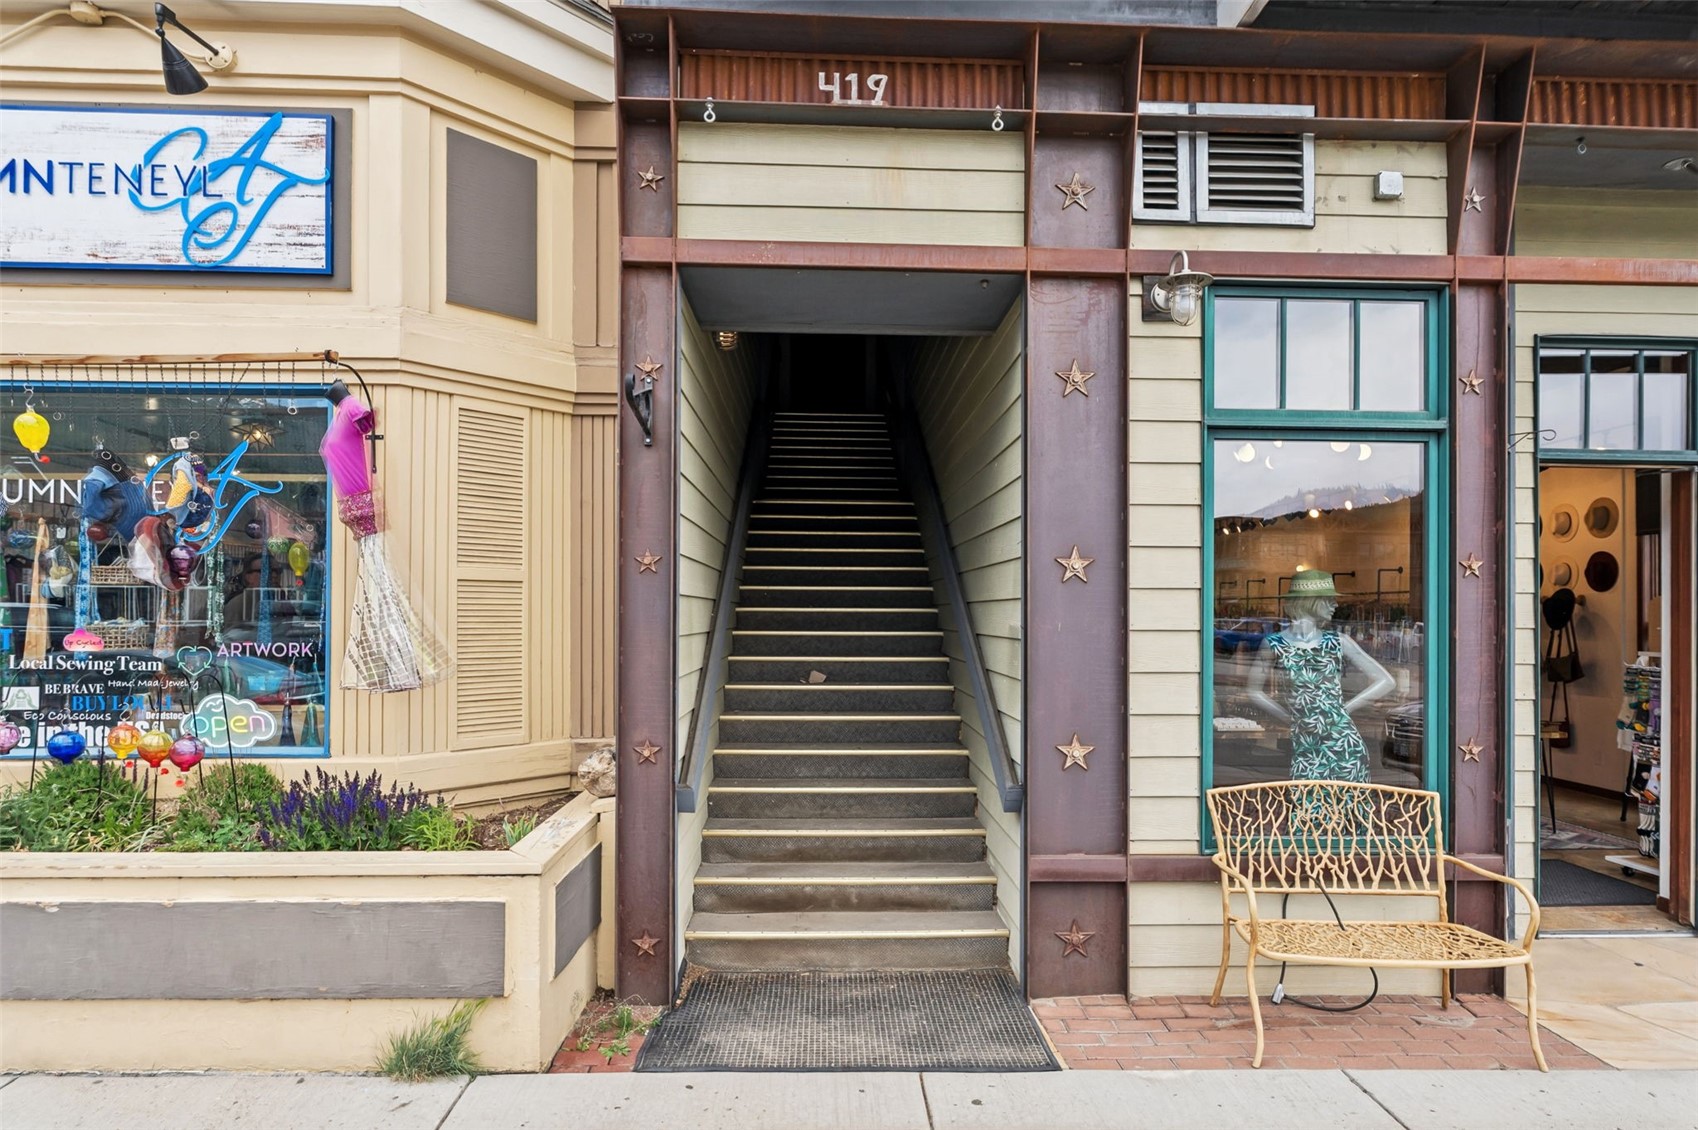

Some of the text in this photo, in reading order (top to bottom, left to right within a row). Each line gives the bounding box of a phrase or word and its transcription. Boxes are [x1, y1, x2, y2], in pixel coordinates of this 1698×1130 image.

[818, 71, 889, 105] 419
[76, 639, 103, 648] Cycled
[217, 642, 313, 658] ARTWORK
[9, 654, 162, 675] Local Sewing Team
[44, 683, 104, 694] BE BRAVE
[72, 695, 109, 711] BUY
[23, 710, 112, 721] Eco Conscious
[146, 711, 187, 721] Deadstoc
[190, 715, 263, 738] open
